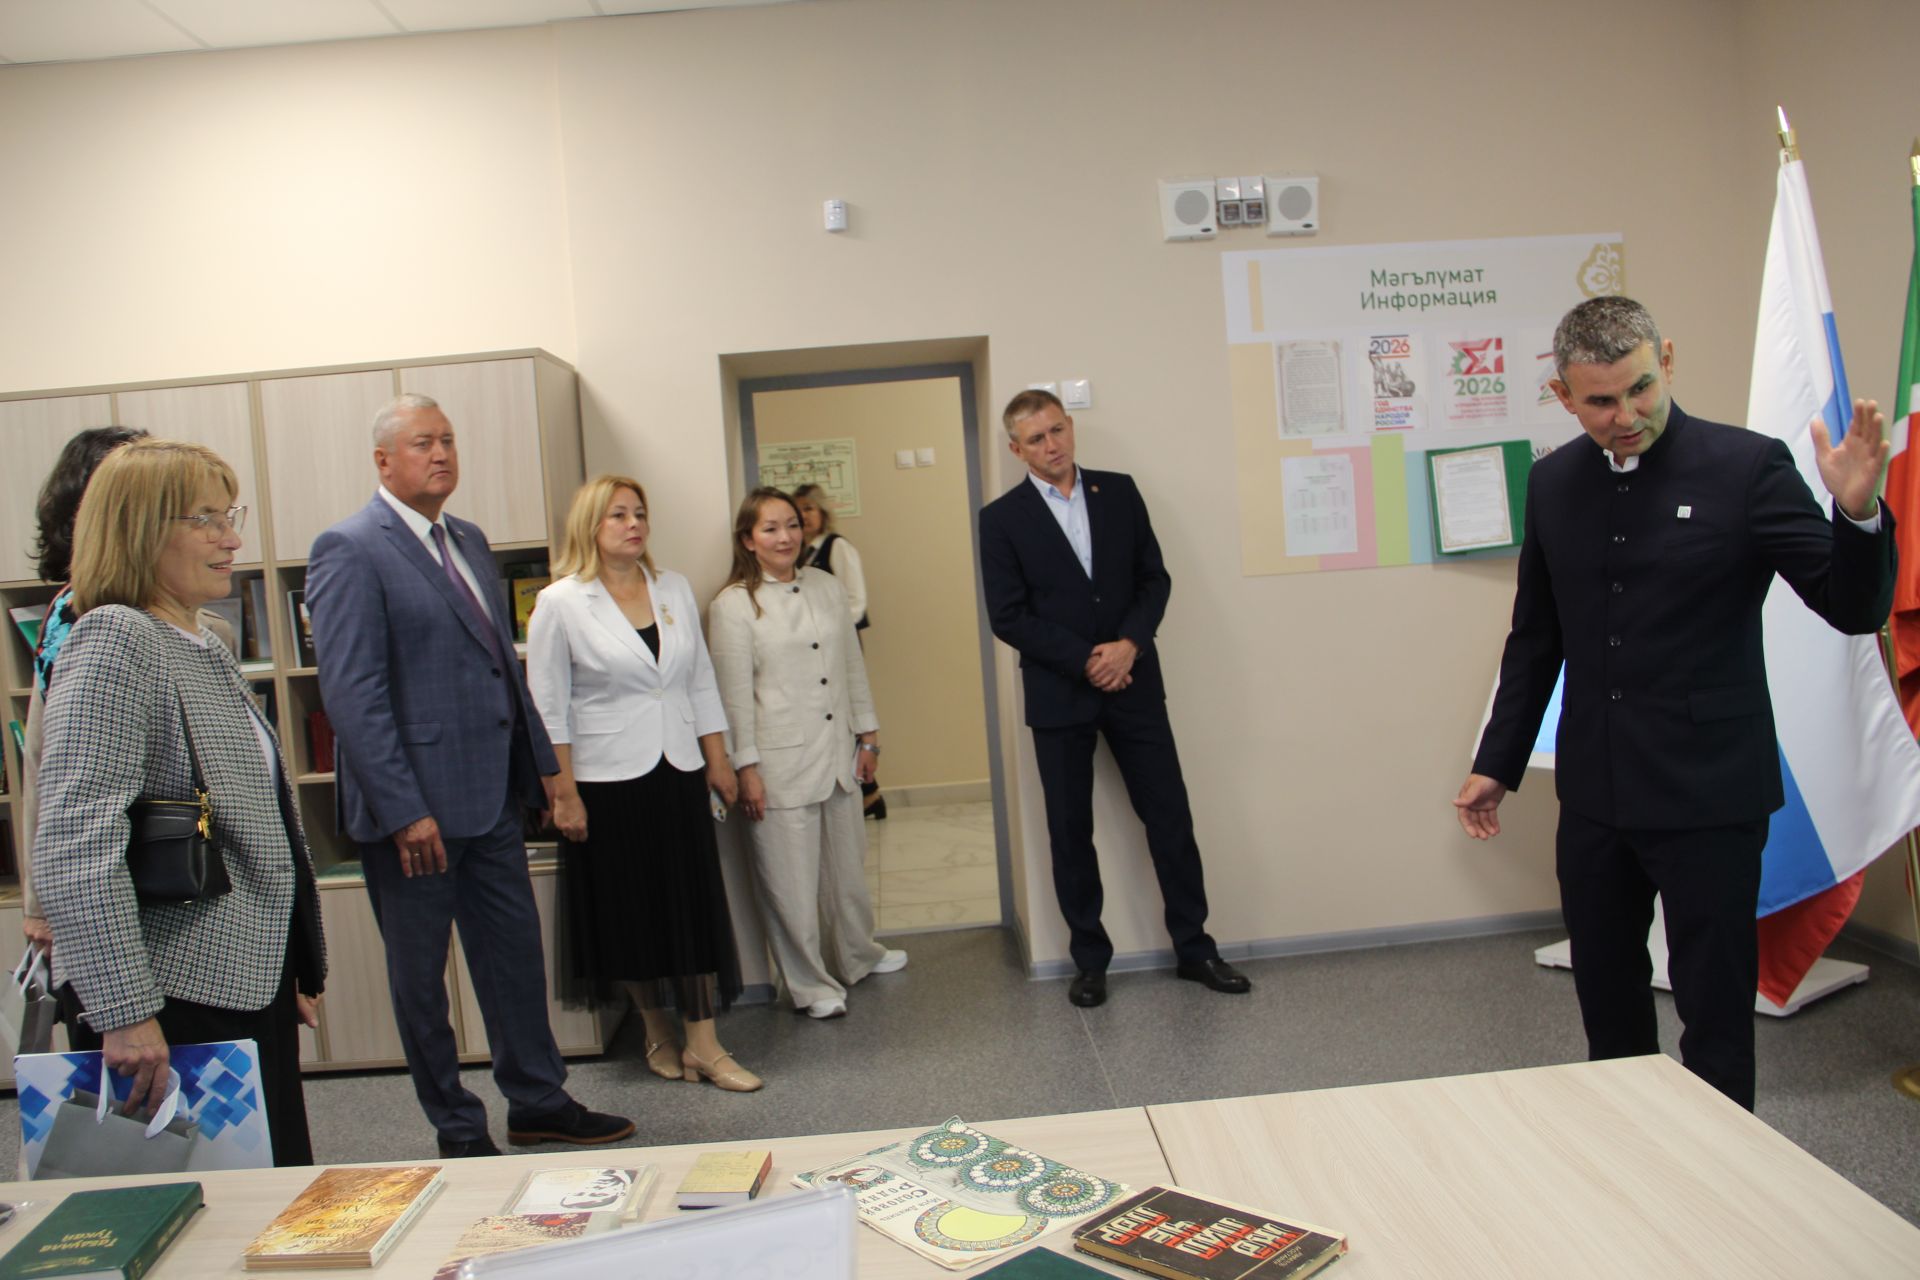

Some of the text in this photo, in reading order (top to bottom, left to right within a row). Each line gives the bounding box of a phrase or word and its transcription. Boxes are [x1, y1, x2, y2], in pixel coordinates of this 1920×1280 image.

[1370, 268, 1484, 289] Мәгълүмат
[1360, 290, 1497, 312] Информация
[1369, 338, 1411, 354] 2026
[1454, 376, 1506, 396] 2026
